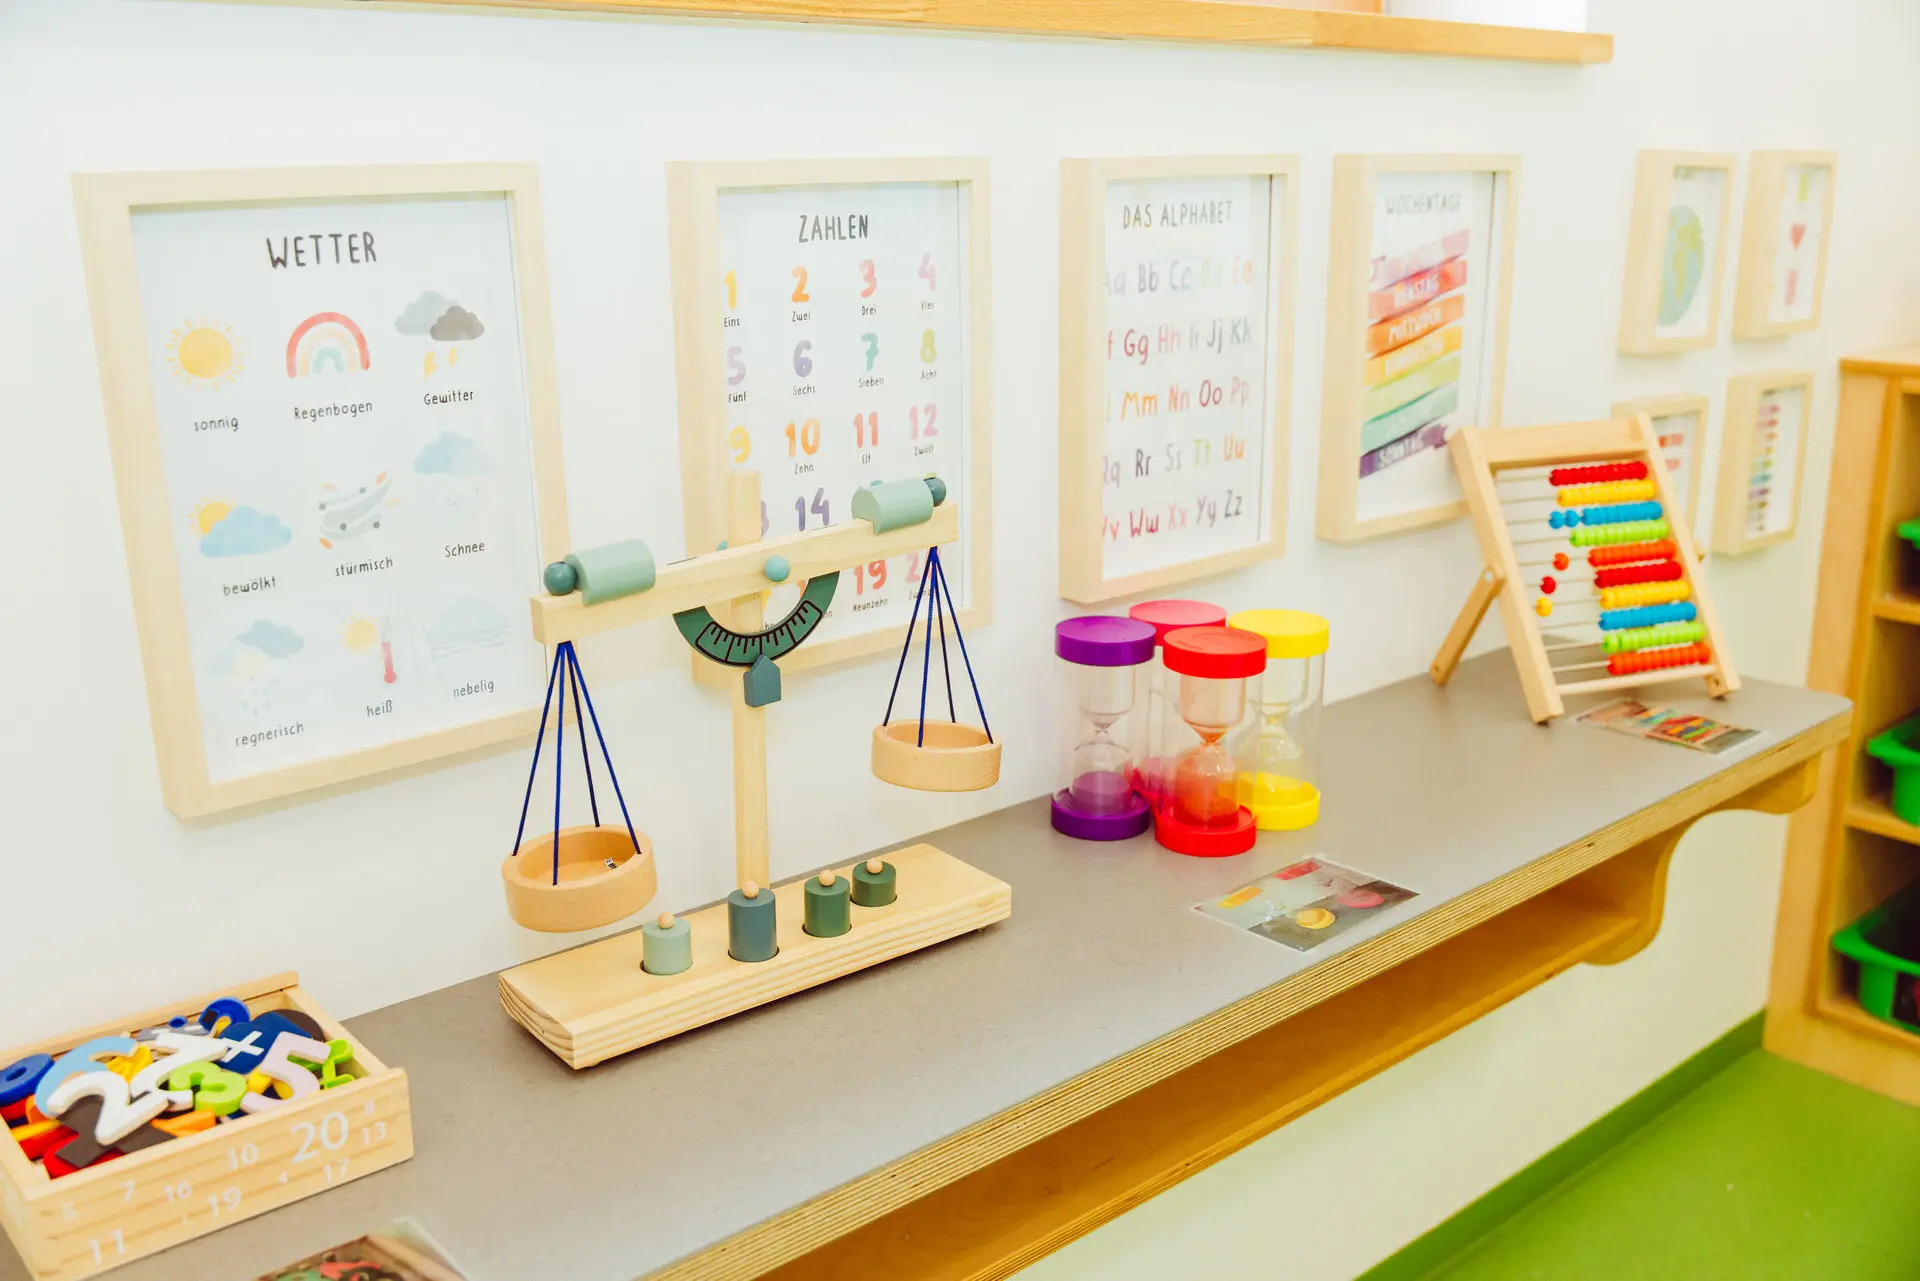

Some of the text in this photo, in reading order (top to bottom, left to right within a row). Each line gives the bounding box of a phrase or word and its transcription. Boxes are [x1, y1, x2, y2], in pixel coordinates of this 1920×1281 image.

[798, 213, 870, 243] ZAHLEN
[1122, 199, 1235, 230] DAS ALPHABET
[266, 230, 377, 269] WETTER
[723, 251, 937, 310] 1 2 3 4
[1138, 262, 1160, 294] Bb
[1169, 259, 1192, 291] Cc
[723, 316, 740, 328] Eins
[791, 310, 812, 323] Zwei
[861, 304, 877, 316] Drei
[1106, 330, 1115, 361] f
[1123, 328, 1149, 365] Gg
[1157, 325, 1181, 355] Hh
[1206, 318, 1224, 354] Jj
[1230, 315, 1252, 347] Kk
[726, 328, 938, 386] 5 6 7 8
[423, 388, 475, 407] Gewitter
[792, 383, 817, 397] Sechs
[1120, 390, 1158, 420] Mm
[1168, 384, 1190, 414] Nn
[1199, 379, 1223, 408] Oo
[1230, 376, 1251, 409] Pp
[193, 414, 240, 433] sonnig
[293, 400, 374, 422] Regenbogen
[729, 402, 939, 464] 9 10 11 12
[794, 462, 816, 475] Zehn
[1134, 448, 1152, 478] Rr
[1164, 443, 1183, 473] Ss
[1192, 438, 1212, 469] Tt
[1223, 433, 1246, 462] Uu
[794, 486, 831, 533] 14
[1128, 507, 1160, 539] Ww
[1168, 502, 1189, 532] Xx
[1196, 494, 1218, 529] Yy
[1223, 489, 1243, 519] Zz
[444, 540, 486, 559] Schnee
[334, 556, 394, 578] stürmisch
[853, 558, 888, 596] 19
[222, 576, 278, 598] bewölkt
[451, 679, 496, 700] nebelig
[366, 699, 394, 719] heiß
[234, 720, 305, 748] regnerisch
[46, 1069, 169, 1146] 2
[290, 1111, 349, 1164] 20
[361, 1121, 388, 1146] 13
[226, 1142, 259, 1171] 10
[323, 1157, 350, 1183] 17
[121, 1179, 136, 1203] 7
[207, 1186, 242, 1218] 19
[88, 1228, 125, 1268] 11
